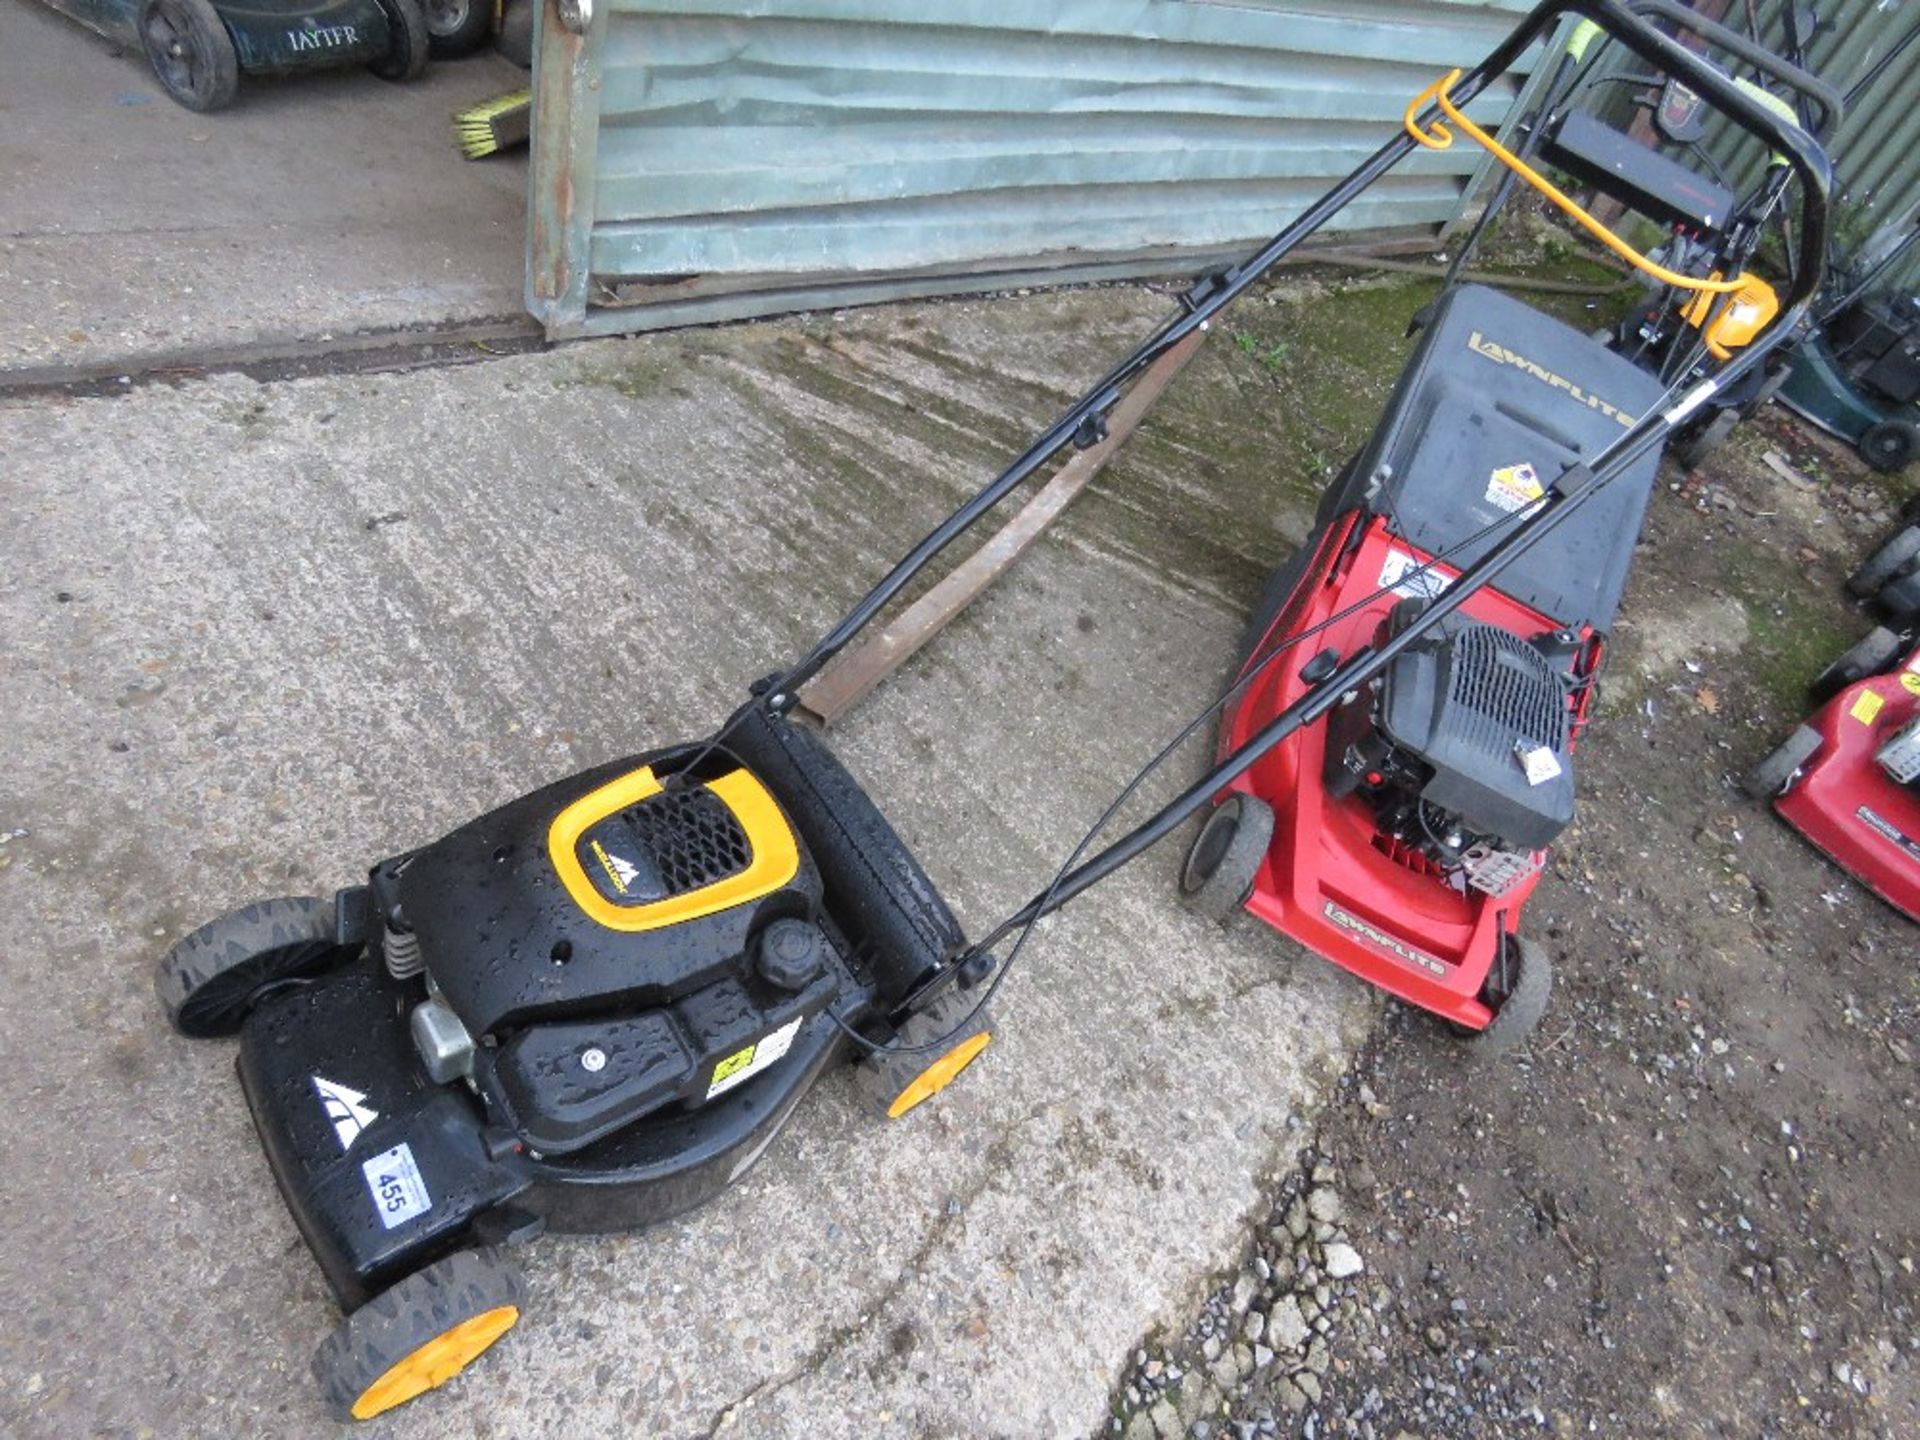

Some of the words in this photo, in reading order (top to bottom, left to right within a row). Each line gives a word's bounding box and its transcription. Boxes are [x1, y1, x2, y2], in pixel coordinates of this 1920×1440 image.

[1467, 330, 1638, 429] LAWNFLITE
[1323, 901, 1446, 975] LAWNFLITE
[378, 1174, 407, 1213] 455
